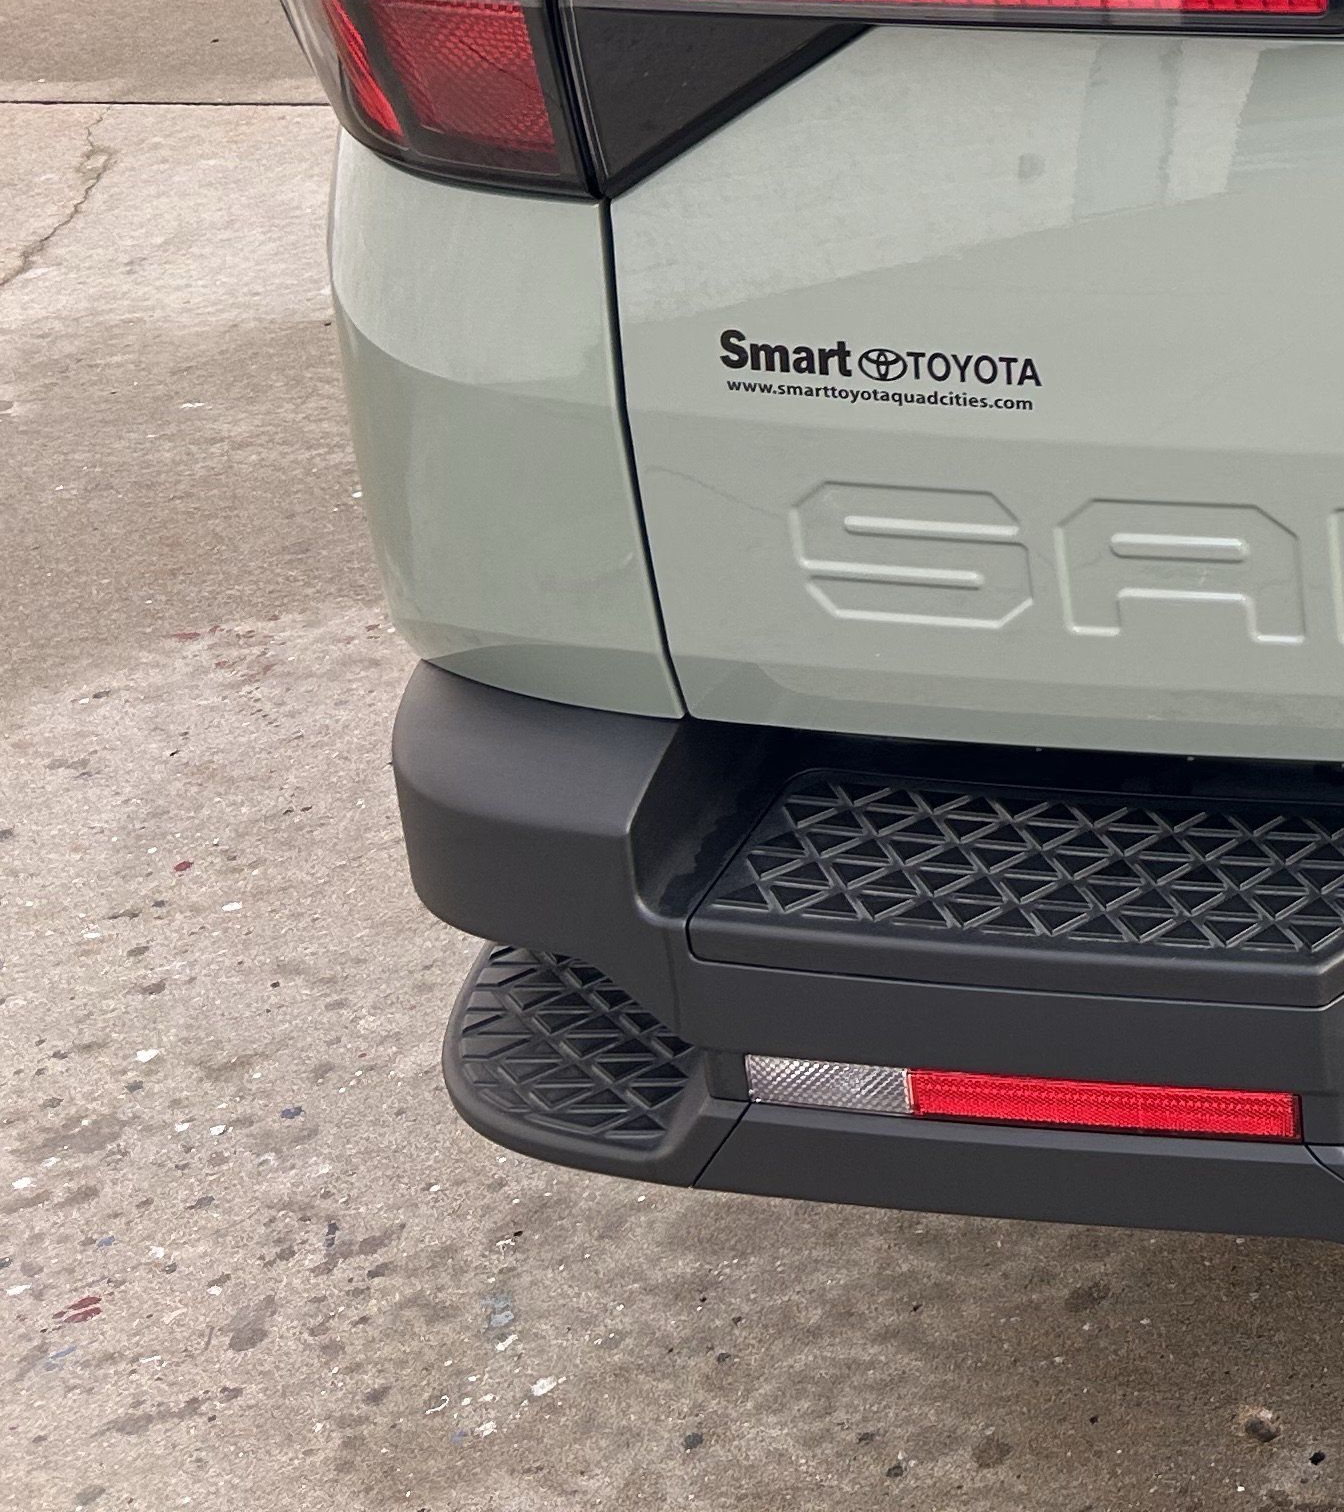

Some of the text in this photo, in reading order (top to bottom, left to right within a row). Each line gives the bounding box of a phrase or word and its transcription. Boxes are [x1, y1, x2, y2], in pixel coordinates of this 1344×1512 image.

[719, 329, 1043, 388] Smart TOYOTA
[726, 378, 1034, 411] www.smarttoyotaquadcities.com
